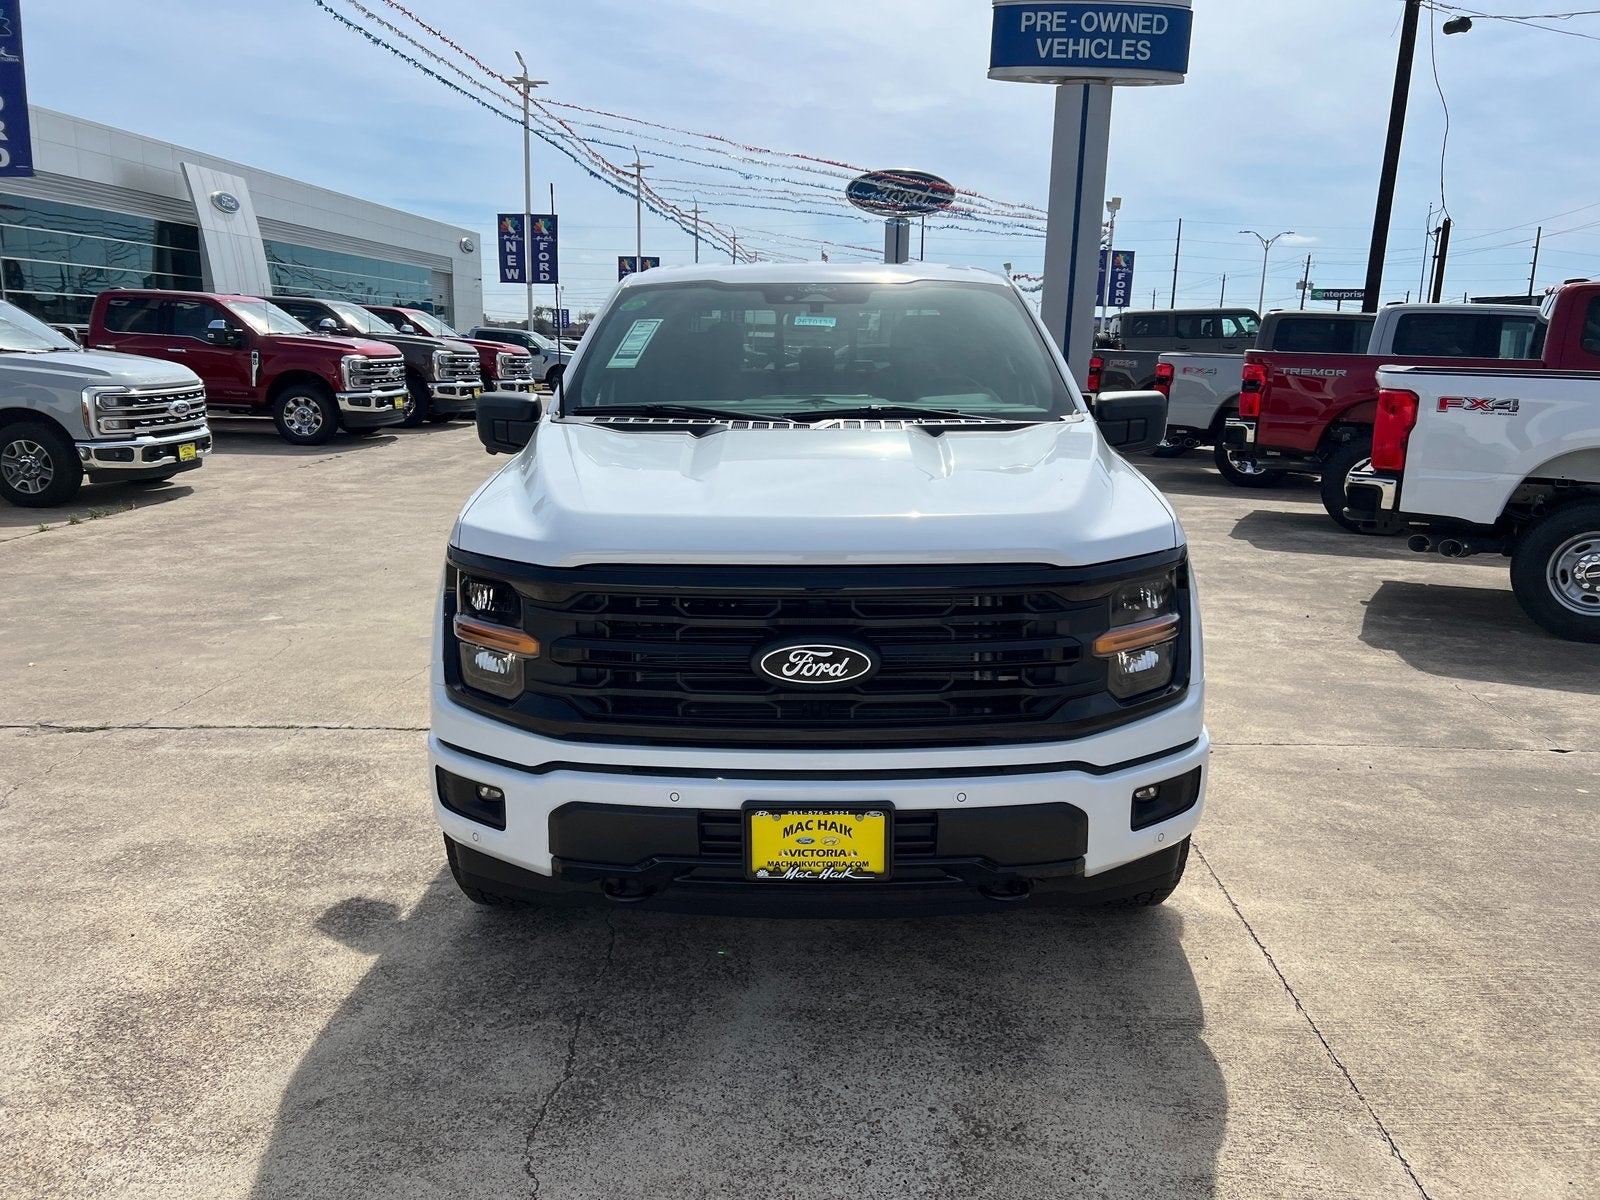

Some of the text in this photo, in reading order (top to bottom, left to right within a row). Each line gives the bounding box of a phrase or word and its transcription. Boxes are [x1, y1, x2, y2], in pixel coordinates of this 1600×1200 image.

[1036, 38, 1151, 61] VEHICLES
[505, 241, 520, 280] NEW
[538, 242, 550, 281] FORD
[1114, 272, 1126, 305] FORD
[1182, 366, 1218, 376] FX4
[1280, 367, 1348, 377] TREMOR
[1436, 396, 1520, 412] FX4
[782, 650, 850, 677] Ford
[782, 819, 854, 839] MAC HAIK
[788, 849, 848, 857] VICTORIA
[782, 867, 860, 880] Mac Haik
